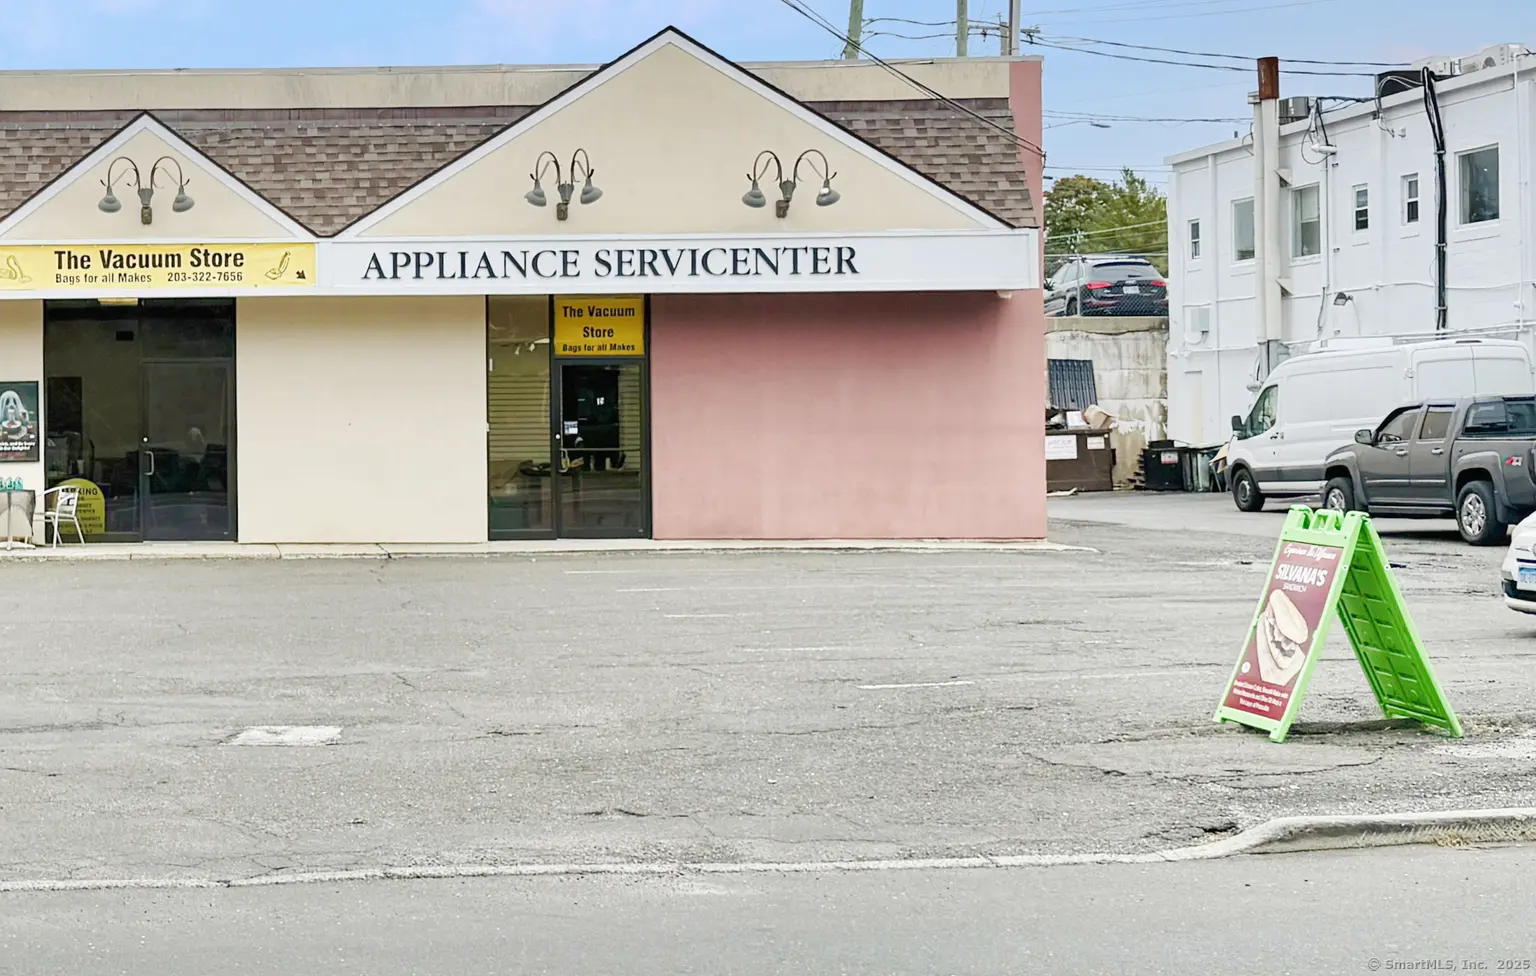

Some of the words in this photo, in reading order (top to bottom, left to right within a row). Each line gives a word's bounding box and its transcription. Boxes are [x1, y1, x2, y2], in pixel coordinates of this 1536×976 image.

[54, 250, 91, 270] The
[99, 249, 182, 269] Vacuum
[189, 248, 245, 268] Store
[362, 250, 581, 280] APPLIANCE
[594, 245, 861, 277] SERVICENTER
[55, 273, 81, 286] Bags
[84, 273, 98, 283] for
[101, 273, 115, 283] all
[117, 273, 152, 283] Makes
[167, 271, 243, 282] 203-322-7656
[562, 305, 583, 318] The
[587, 304, 636, 318] Vacuum
[582, 326, 615, 339] Store
[562, 343, 581, 353] Bags
[584, 343, 595, 352] for
[597, 343, 607, 352] all
[609, 343, 636, 352] Makes
[1275, 563, 1329, 587] SILVANA'S
